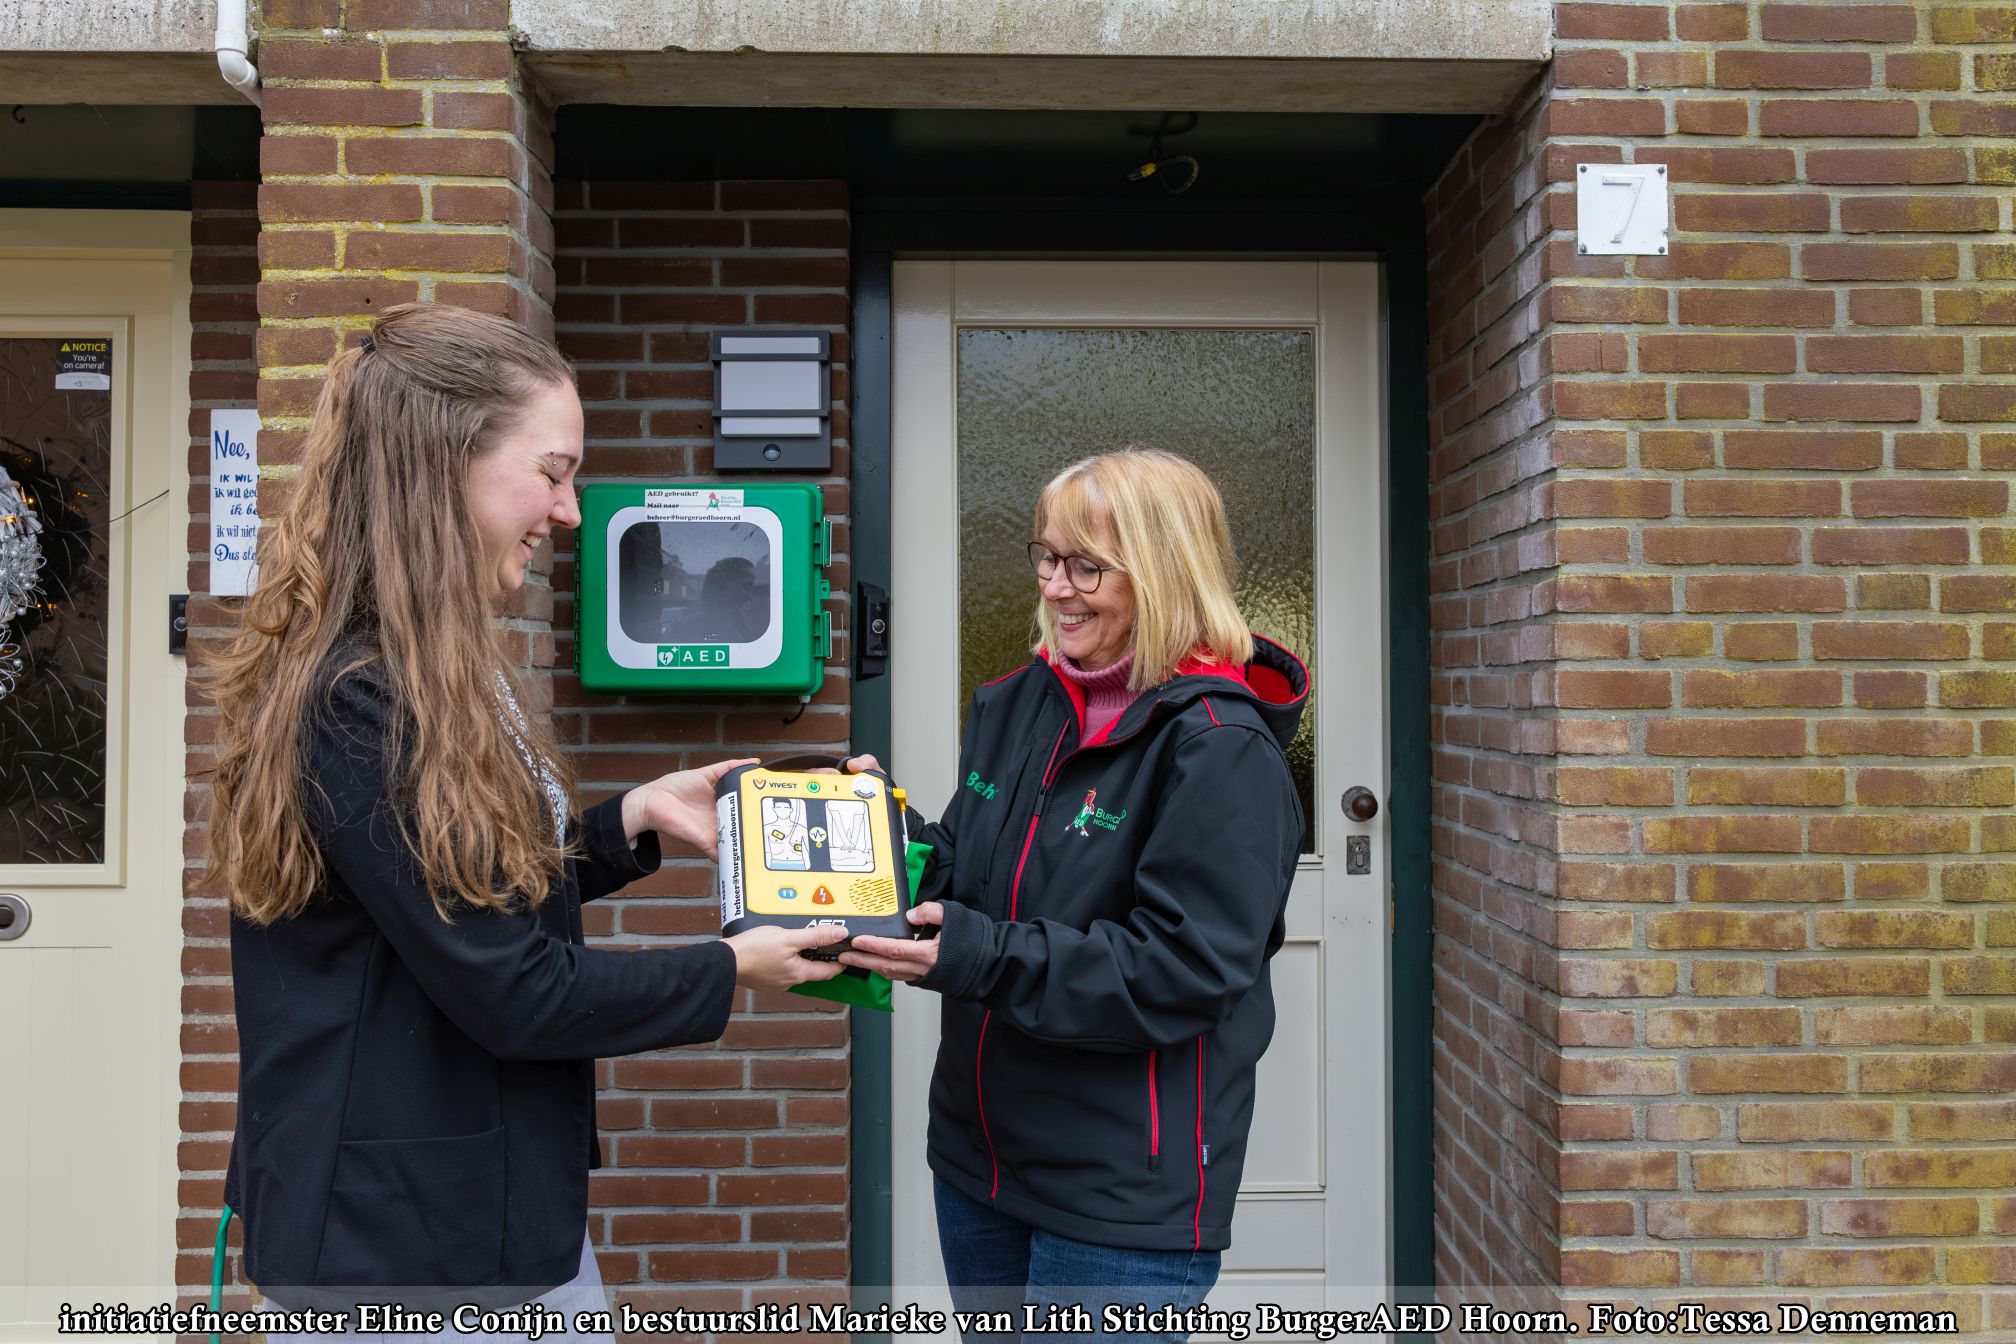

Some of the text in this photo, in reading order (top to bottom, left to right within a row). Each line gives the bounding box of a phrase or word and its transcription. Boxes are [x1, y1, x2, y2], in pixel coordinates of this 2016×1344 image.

[1601, 174, 1645, 244] 7
[72, 343, 107, 352] NOTICE
[73, 353, 97, 362] You're
[75, 361, 105, 370] camera!
[214, 429, 250, 460] Nee,
[219, 474, 230, 483] IK
[234, 474, 253, 483] WIL
[214, 487, 224, 498] ik
[226, 487, 241, 498] wil
[230, 504, 243, 516] ik
[216, 525, 256, 538] ik wil niet
[214, 543, 240, 562] Dus
[682, 650, 726, 663] AED
[966, 770, 1000, 801] Beh
[728, 795, 741, 916] beheer@burgeraedhoorn.nl
